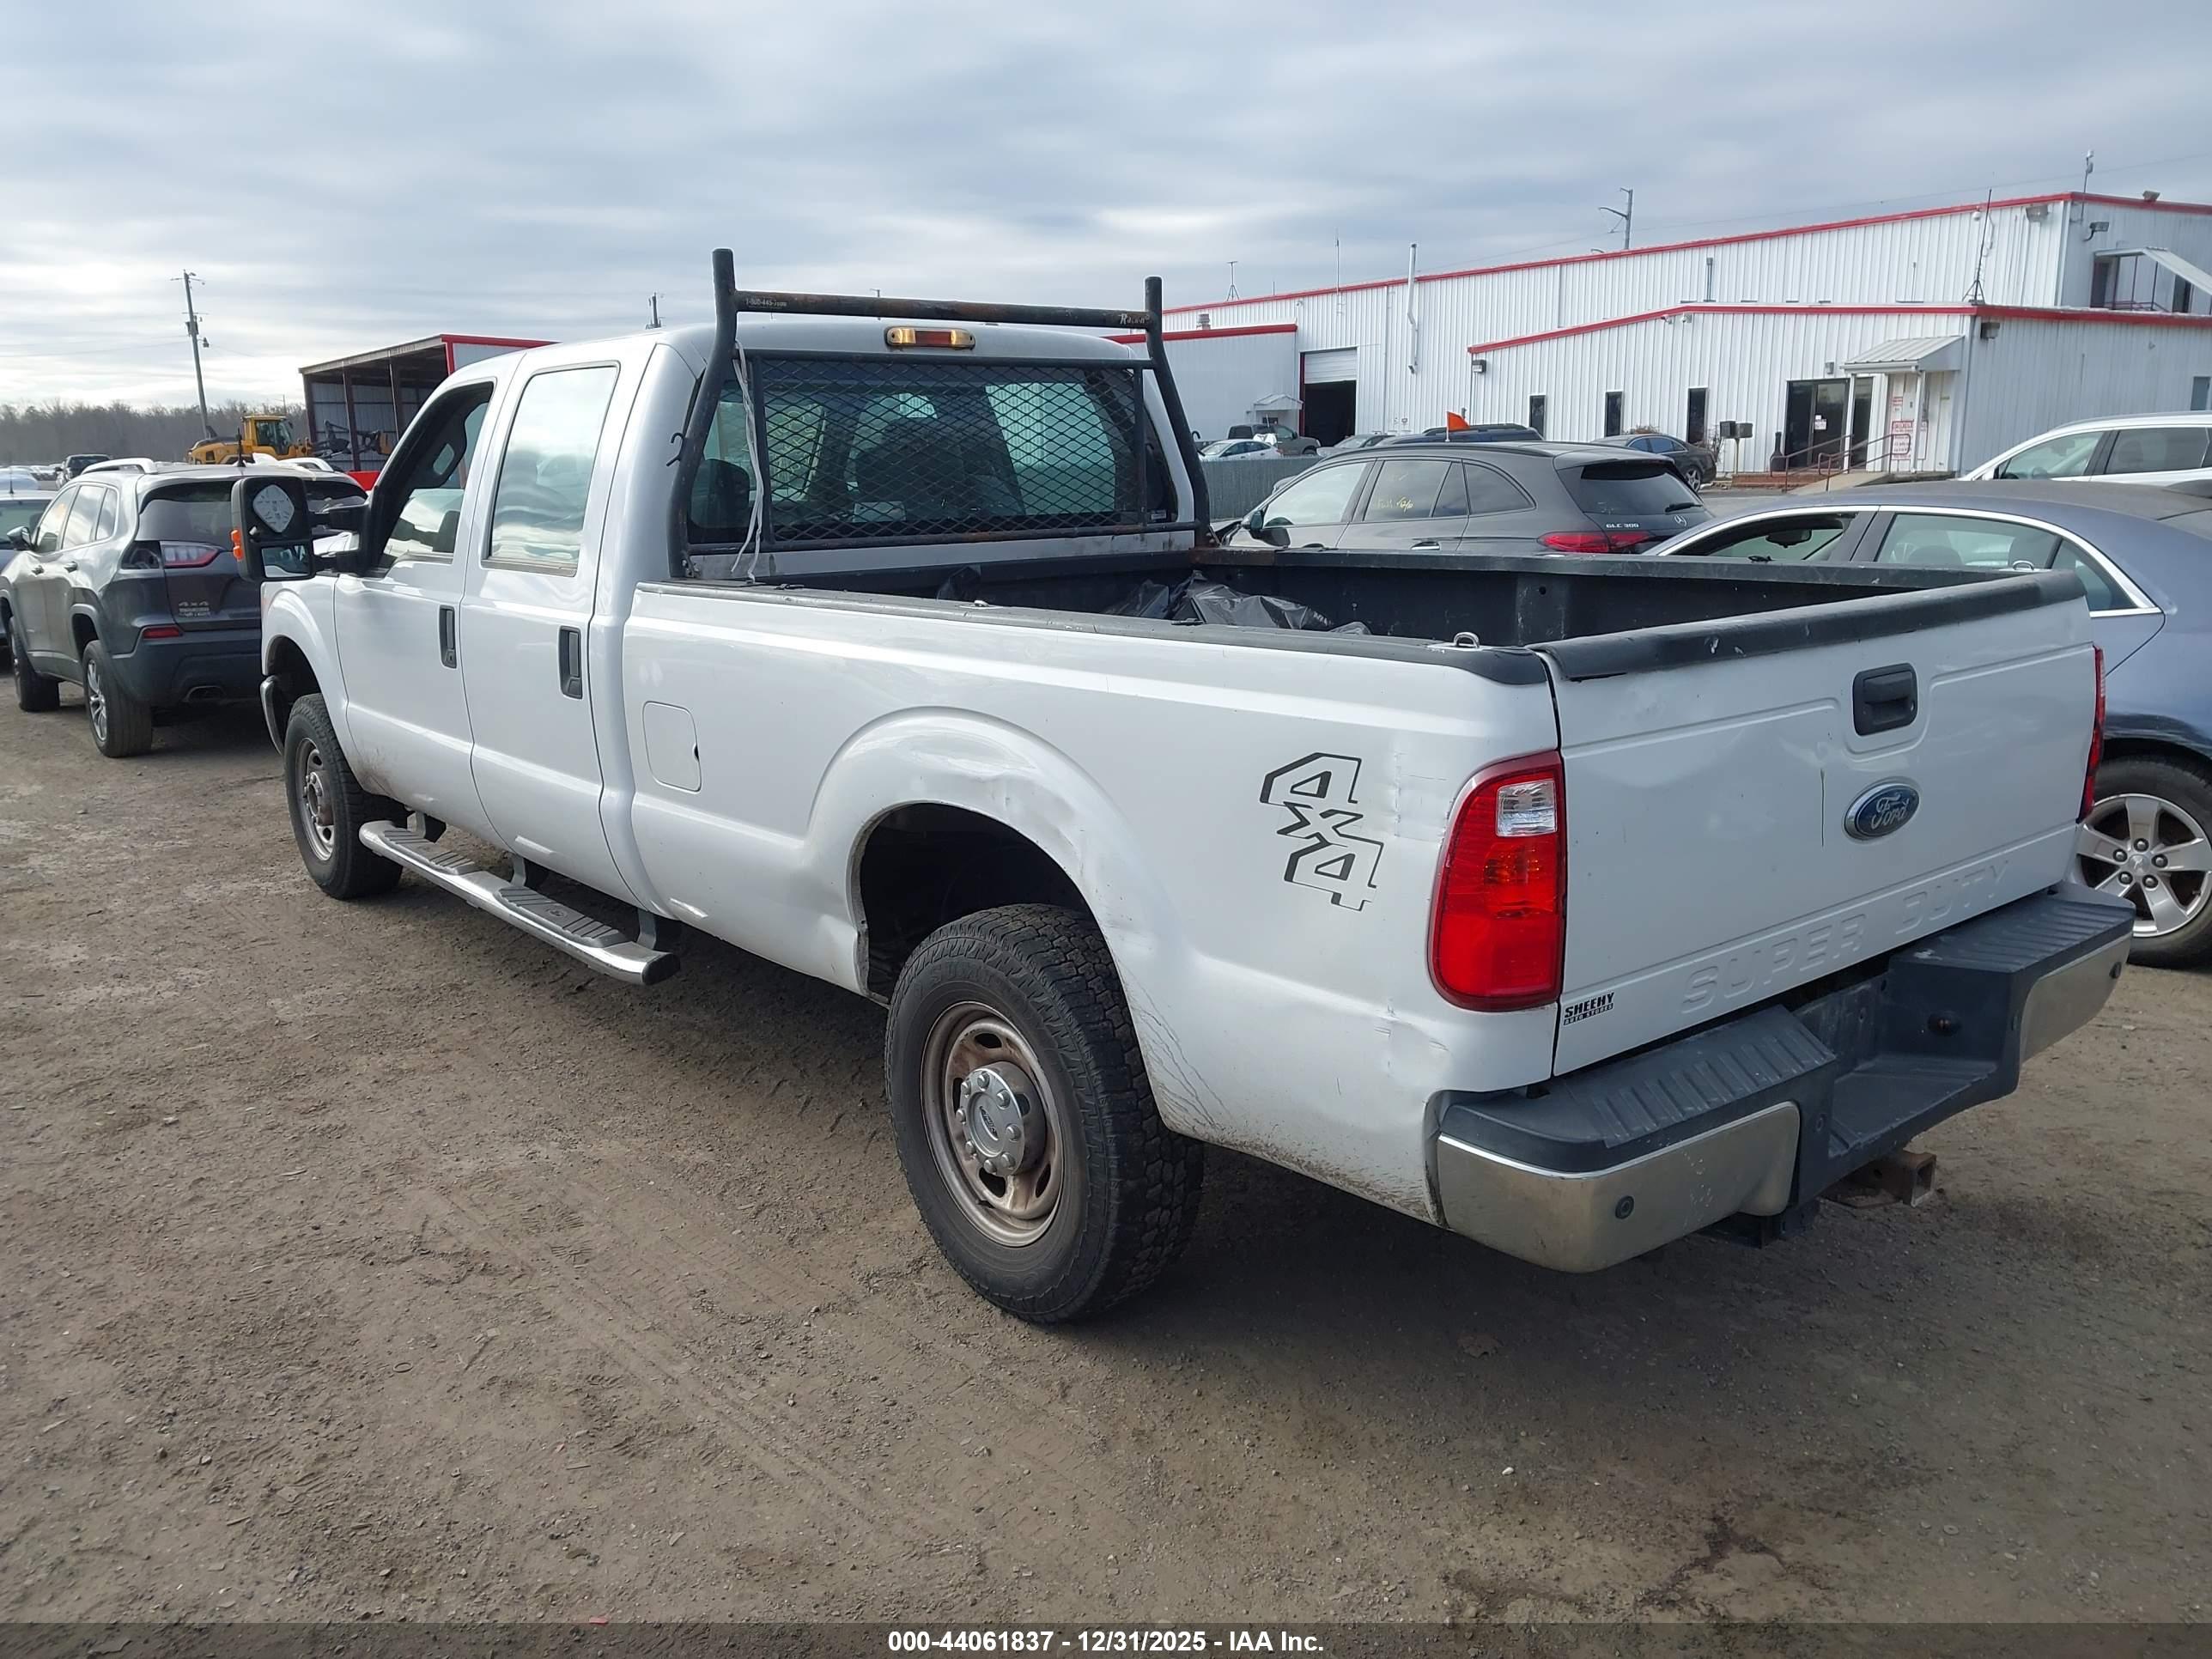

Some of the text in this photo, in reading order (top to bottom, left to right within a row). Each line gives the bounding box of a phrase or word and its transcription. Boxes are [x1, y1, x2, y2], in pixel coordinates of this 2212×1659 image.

[1680, 860, 2010, 1015] SUPER DUTY
[1565, 993, 1614, 1018] SHEEHY
